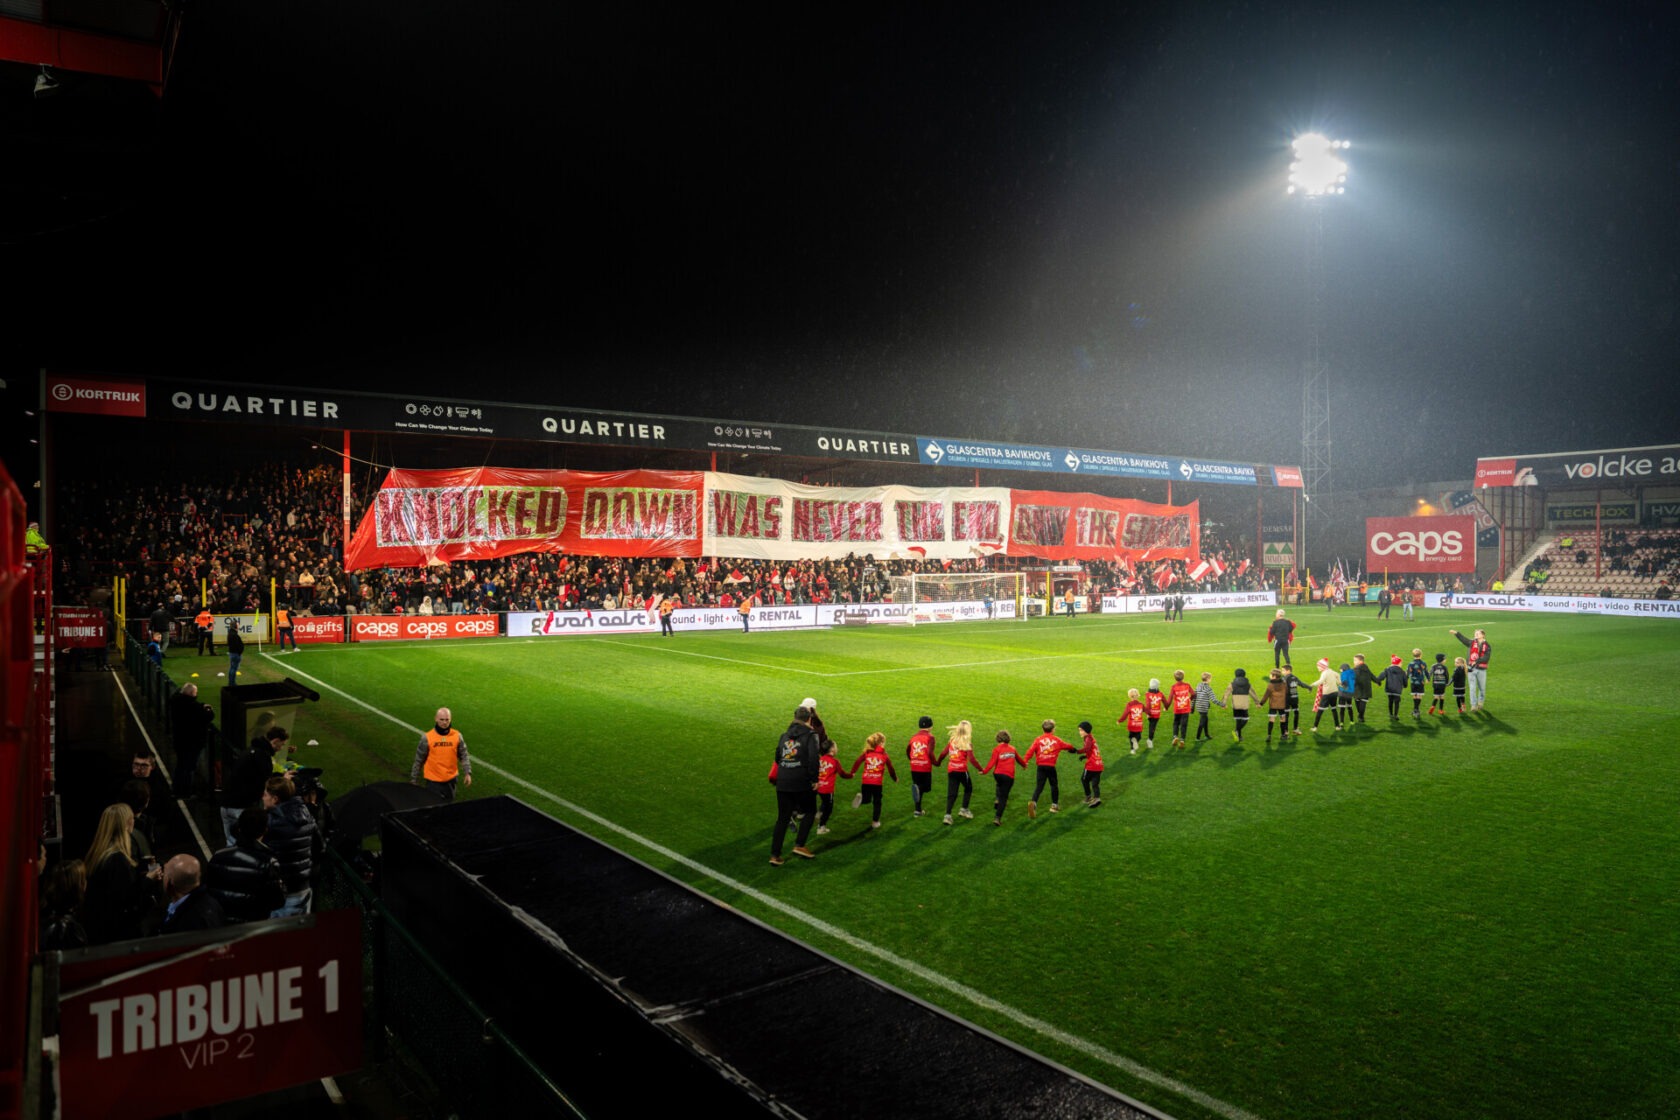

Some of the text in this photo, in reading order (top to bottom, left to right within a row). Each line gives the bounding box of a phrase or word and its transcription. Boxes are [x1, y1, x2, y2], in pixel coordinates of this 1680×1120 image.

[76, 388, 141, 402] KORTRIJK
[171, 391, 339, 419] QUARTIER
[542, 417, 666, 440] QUARTIER
[817, 436, 911, 456] QUARTIER
[946, 444, 1052, 461] GLASCENTRA BAVIKHOVE
[1081, 454, 1169, 469] GLASCENTRA BAVIKHOVE
[1564, 455, 1653, 479] volcke
[377, 489, 561, 543] KNOCKED
[585, 491, 693, 537] DOWN
[713, 490, 781, 538] WAS
[793, 499, 883, 541] NEVER
[895, 500, 944, 541] THE
[1076, 508, 1118, 547] THE
[1371, 530, 1463, 562] caps
[1543, 600, 1570, 608] sound
[1577, 600, 1597, 609] light
[1604, 602, 1630, 611] video
[704, 614, 724, 625] light
[760, 610, 802, 621] RENTAL
[58, 626, 104, 637] TRIBUNE 1
[356, 620, 495, 637] caps caps caps
[89, 959, 339, 1060] TRIBUNE 1
[179, 1033, 255, 1070] VIP 2
